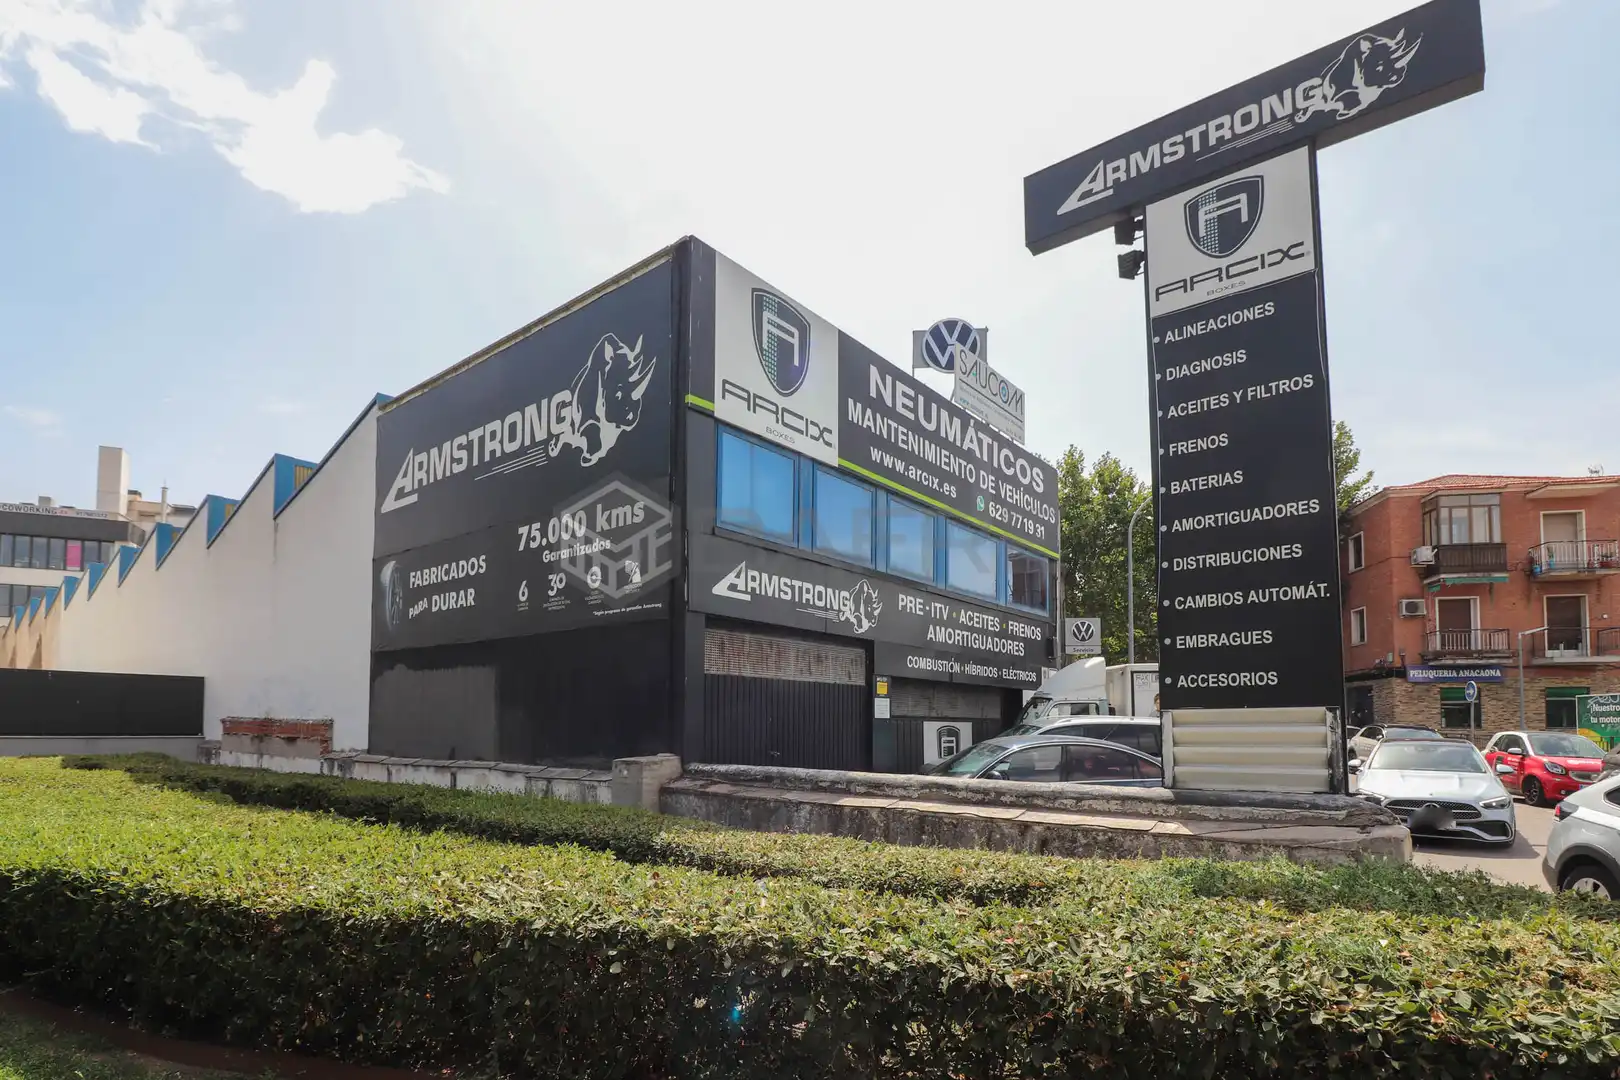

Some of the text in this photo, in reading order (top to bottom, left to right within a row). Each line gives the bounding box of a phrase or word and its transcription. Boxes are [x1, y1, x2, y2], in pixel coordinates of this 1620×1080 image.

[1056, 76, 1323, 216] ARMSTRONG
[1155, 241, 1305, 302] ARCIX
[1206, 280, 1246, 296] BOXES
[1164, 302, 1275, 344] ALINEACIONES
[1166, 349, 1247, 381] DIAGNOSIS
[959, 349, 1023, 416] SAUCOM
[1167, 374, 1314, 419] ACEITES Y FILTROS
[721, 378, 834, 448] ARCIX
[869, 363, 1045, 494] NEUMÁTICOS
[765, 426, 796, 444] BOXES
[1169, 433, 1229, 457] FRENOS
[381, 389, 574, 514] ARMSTRONG
[847, 397, 976, 484] MANTENIMIENTO
[979, 469, 996, 494] DE
[998, 477, 1056, 525] VEHÍCULOS
[870, 446, 957, 499] www.arcix.es
[1170, 470, 1244, 495] BATERIAS
[517, 501, 645, 551] 75.000 kms
[989, 501, 1009, 523] 629
[1171, 499, 1320, 533] AMORTIGUADORES
[542, 537, 612, 563] Garantizados
[1173, 543, 1303, 571] DISTRIBUCIONES
[409, 555, 487, 588] FABRICADOS
[518, 580, 529, 601] 6
[548, 572, 567, 597] 30
[712, 561, 851, 613] ARMSTRONG
[432, 588, 476, 612] DURAR
[1174, 581, 1330, 610] CAMBIOS AUTOMÁT.
[926, 624, 1025, 657] AMORTIGUADORES
[959, 608, 1000, 633] ACEITES
[1008, 620, 1042, 642] FRENOS
[1176, 630, 1273, 649] EMBRAGUES
[907, 655, 1037, 682] COMBUSTIÓN HÍBRIDOS ELÉCTRICOS
[1177, 671, 1278, 688] ACCESORIOS
[1409, 669, 1457, 678] PELUQUERIA
[1590, 716, 1597, 724] tu
